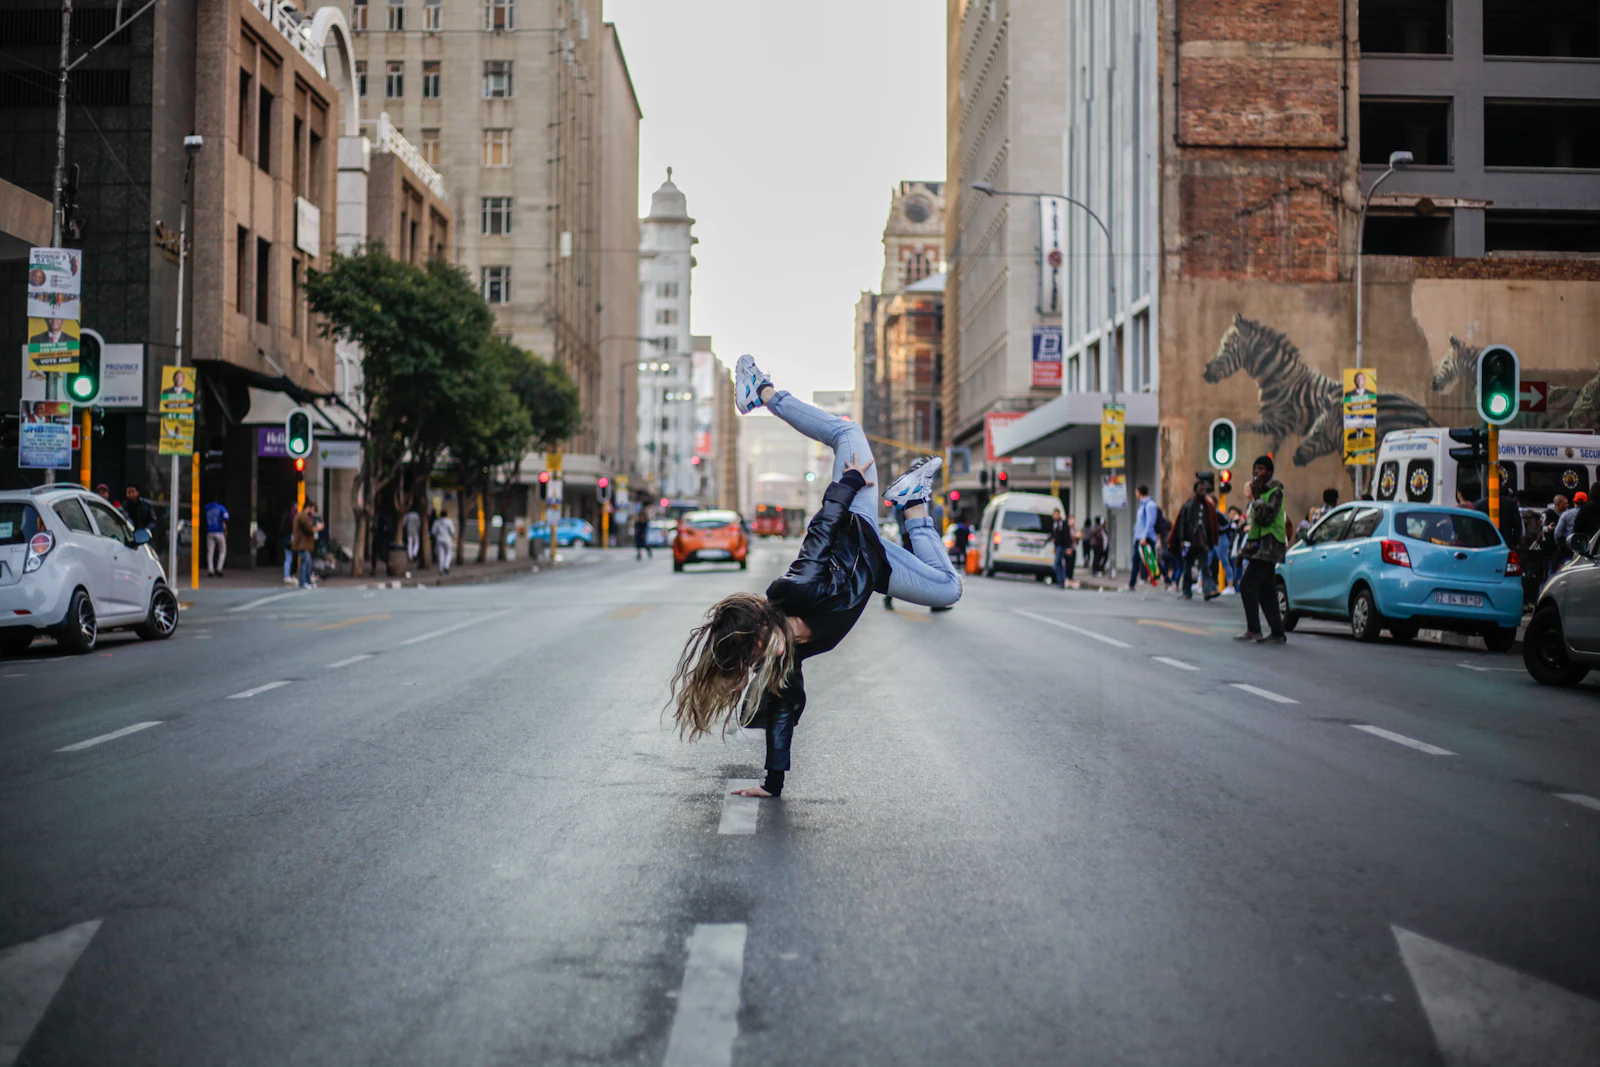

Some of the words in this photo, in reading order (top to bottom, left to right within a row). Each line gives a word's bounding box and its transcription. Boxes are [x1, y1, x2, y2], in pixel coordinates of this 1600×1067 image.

[105, 363, 139, 371] PROVINCE
[23, 425, 44, 433] JHB
[1517, 446, 1527, 455] TO
[1528, 446, 1559, 457] PROTECT
